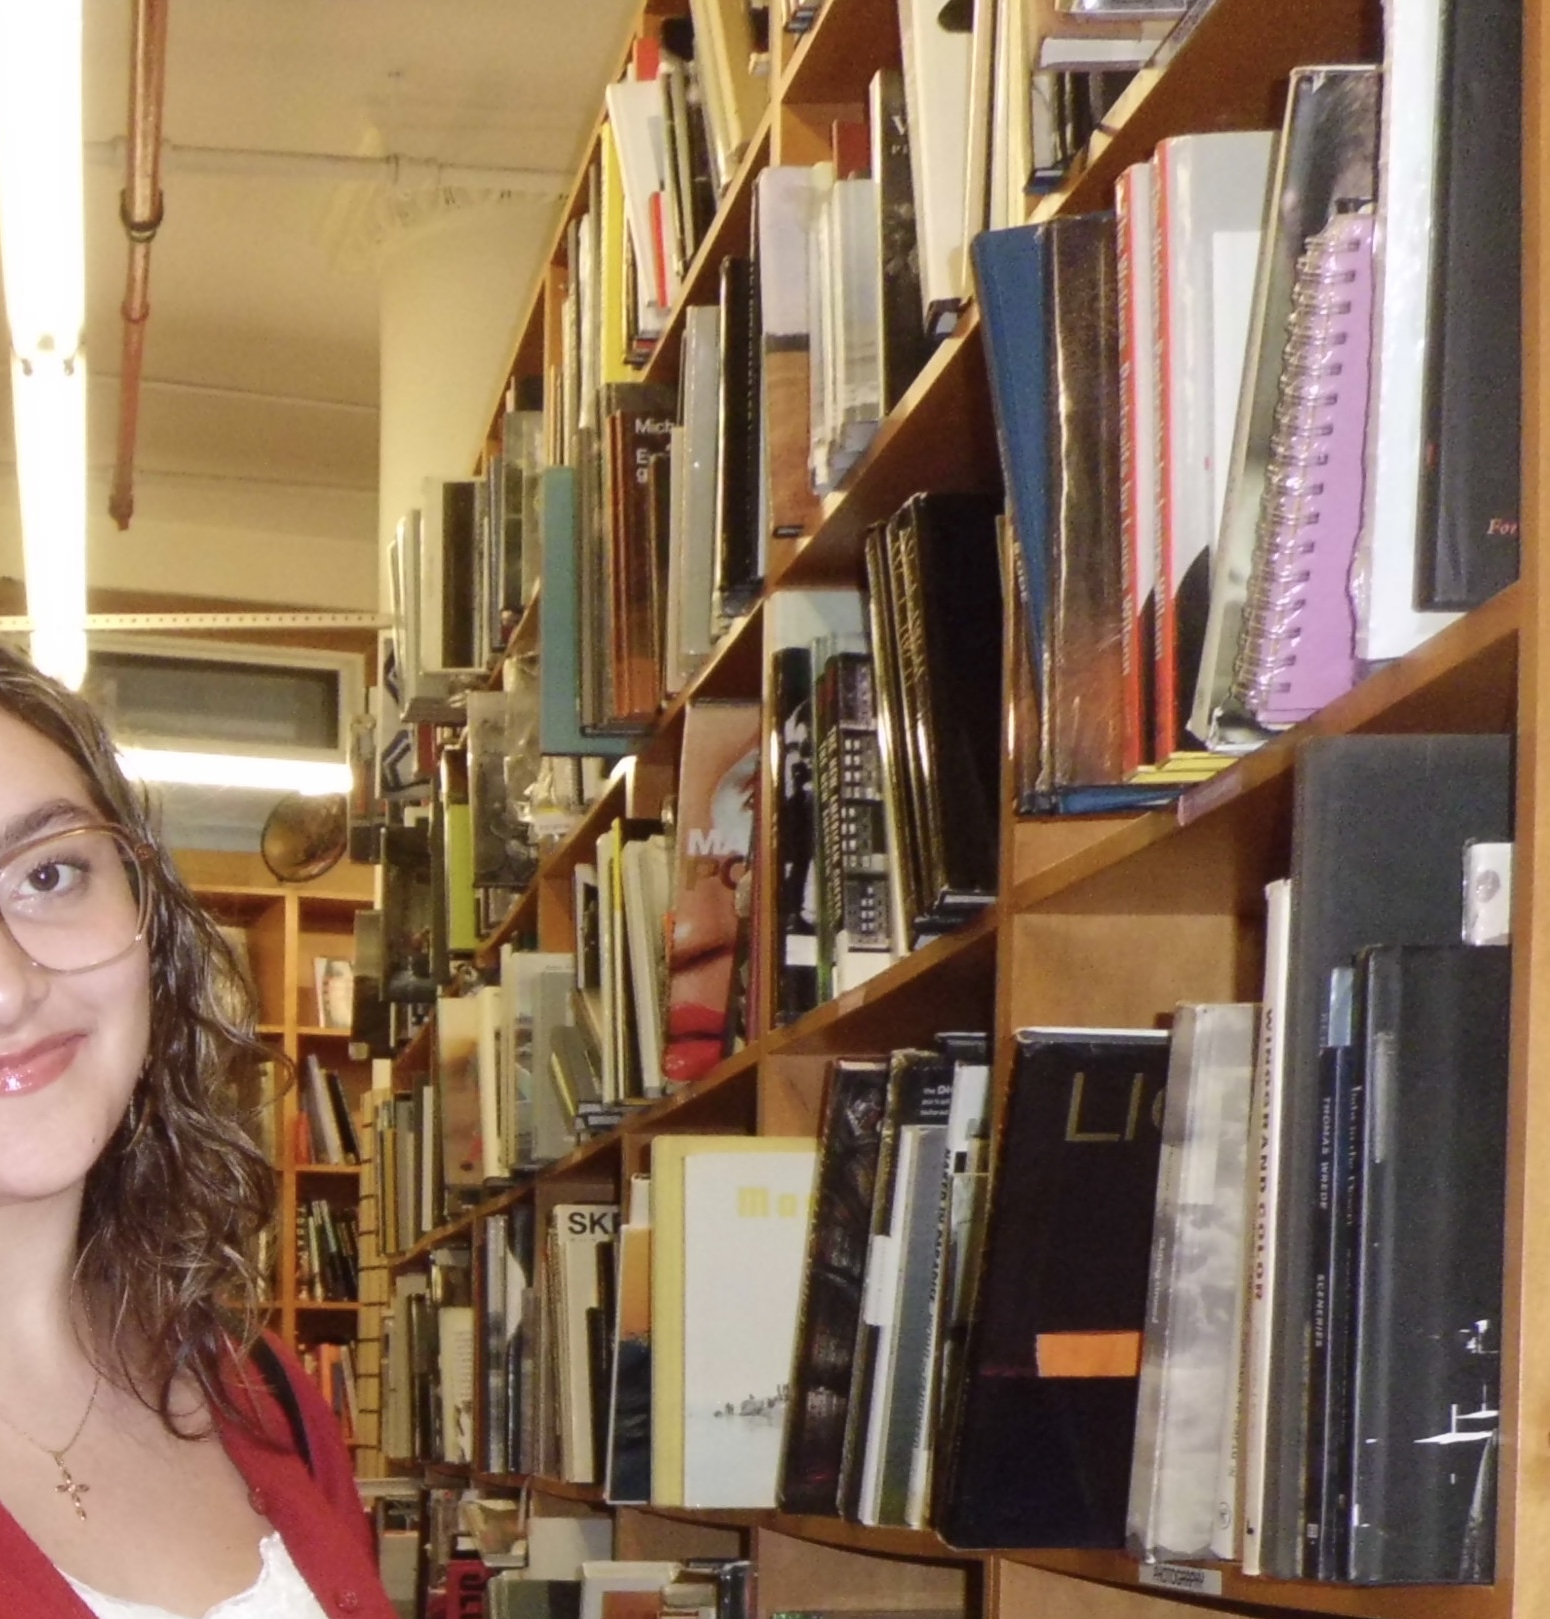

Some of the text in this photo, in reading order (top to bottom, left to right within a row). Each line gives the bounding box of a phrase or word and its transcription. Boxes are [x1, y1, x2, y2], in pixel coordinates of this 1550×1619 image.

[1254, 1008, 1273, 1300] WINOGRAND COLOR
[1314, 1096, 1331, 1347] THOMAS WREDE SCENERIES
